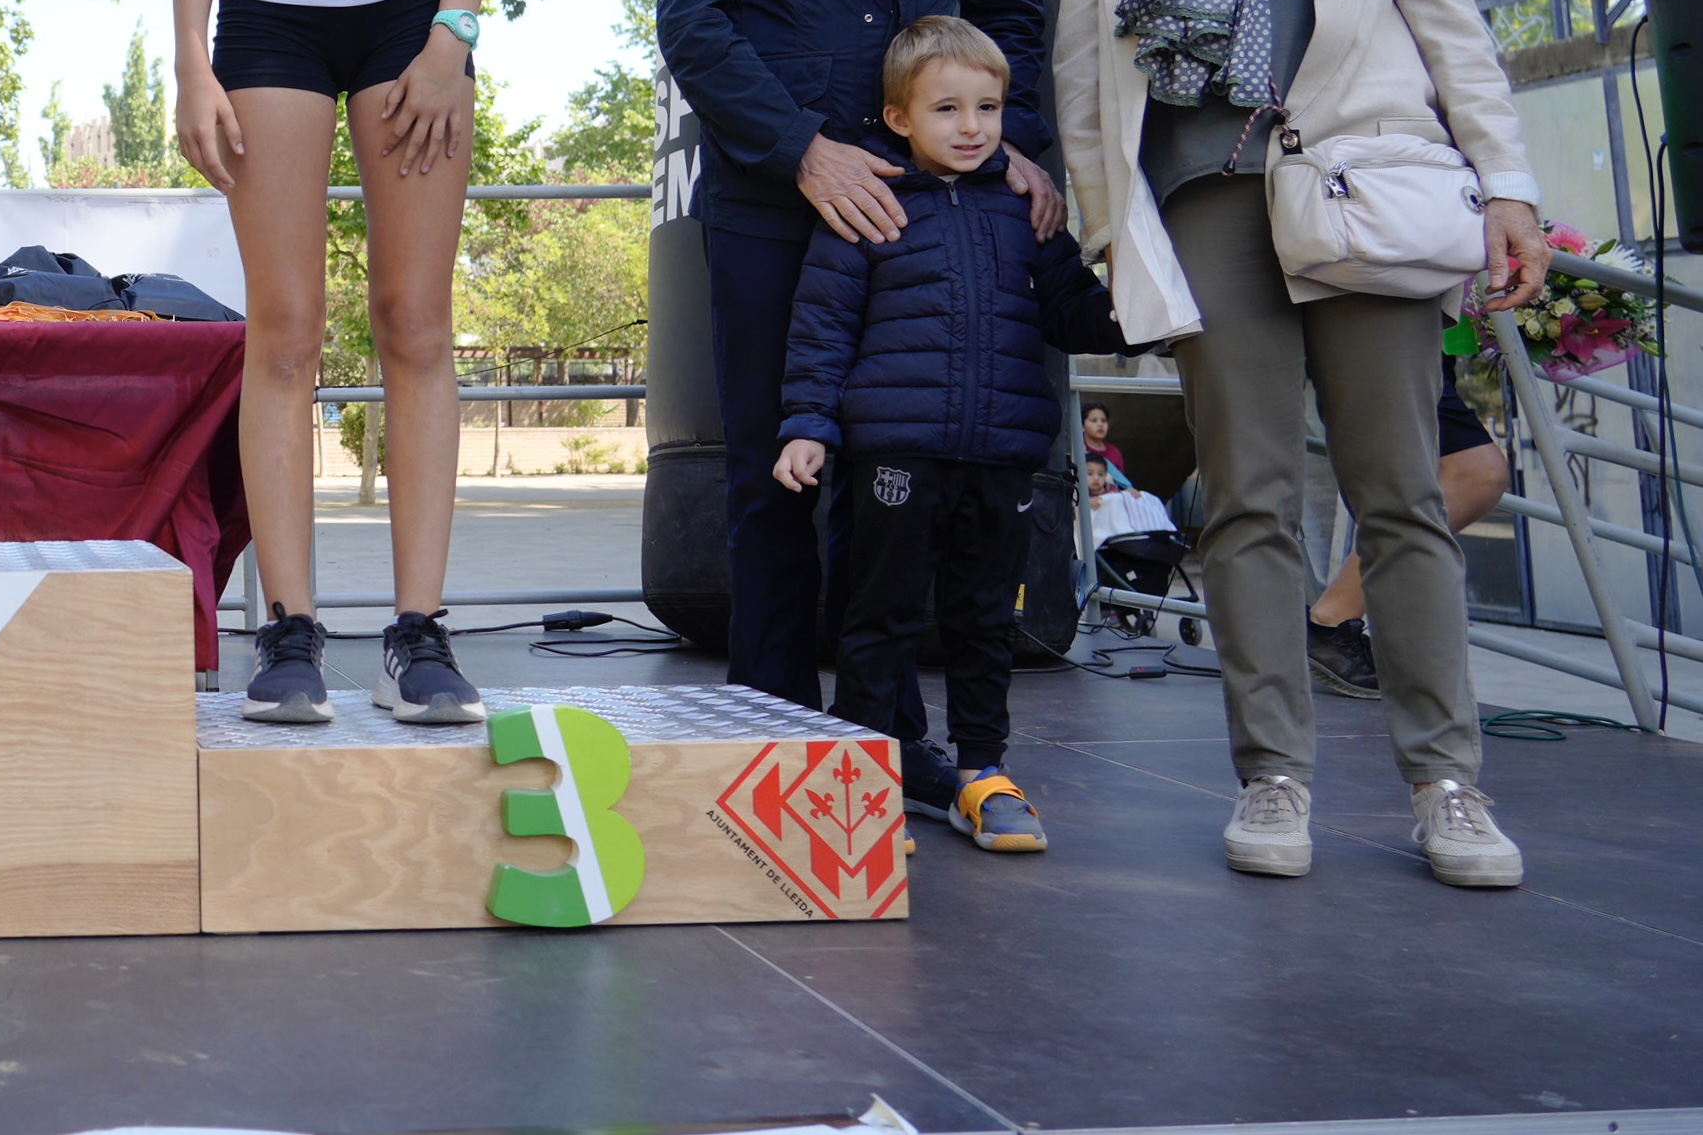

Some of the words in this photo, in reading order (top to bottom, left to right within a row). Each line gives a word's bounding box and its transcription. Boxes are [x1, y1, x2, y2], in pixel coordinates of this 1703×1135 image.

[484, 705, 646, 928] 3
[706, 809, 768, 870] AJUNTAMENT
[766, 869, 782, 885] DE
[780, 882, 814, 919] LLEIDA
